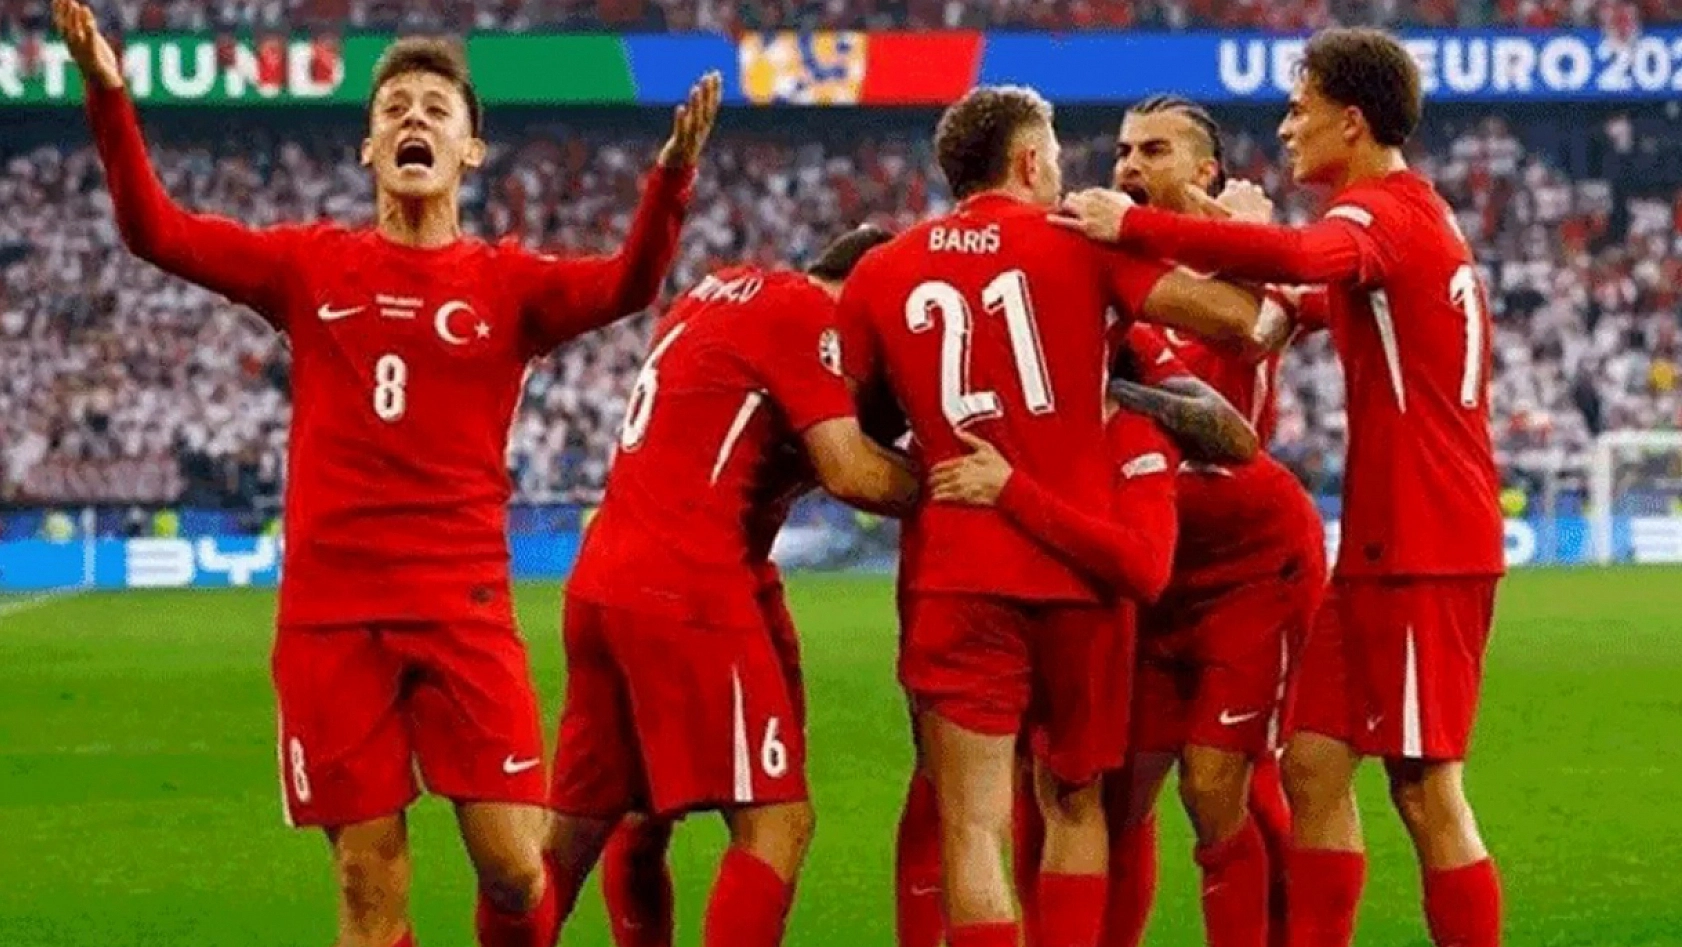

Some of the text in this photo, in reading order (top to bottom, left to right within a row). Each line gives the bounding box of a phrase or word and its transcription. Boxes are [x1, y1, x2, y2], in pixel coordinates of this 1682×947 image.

[905, 268, 1056, 427] 21
[373, 354, 408, 422] 8
[620, 321, 687, 453] 6
[125, 536, 284, 588] BY
[289, 736, 311, 802] 8
[761, 716, 788, 778] 6
